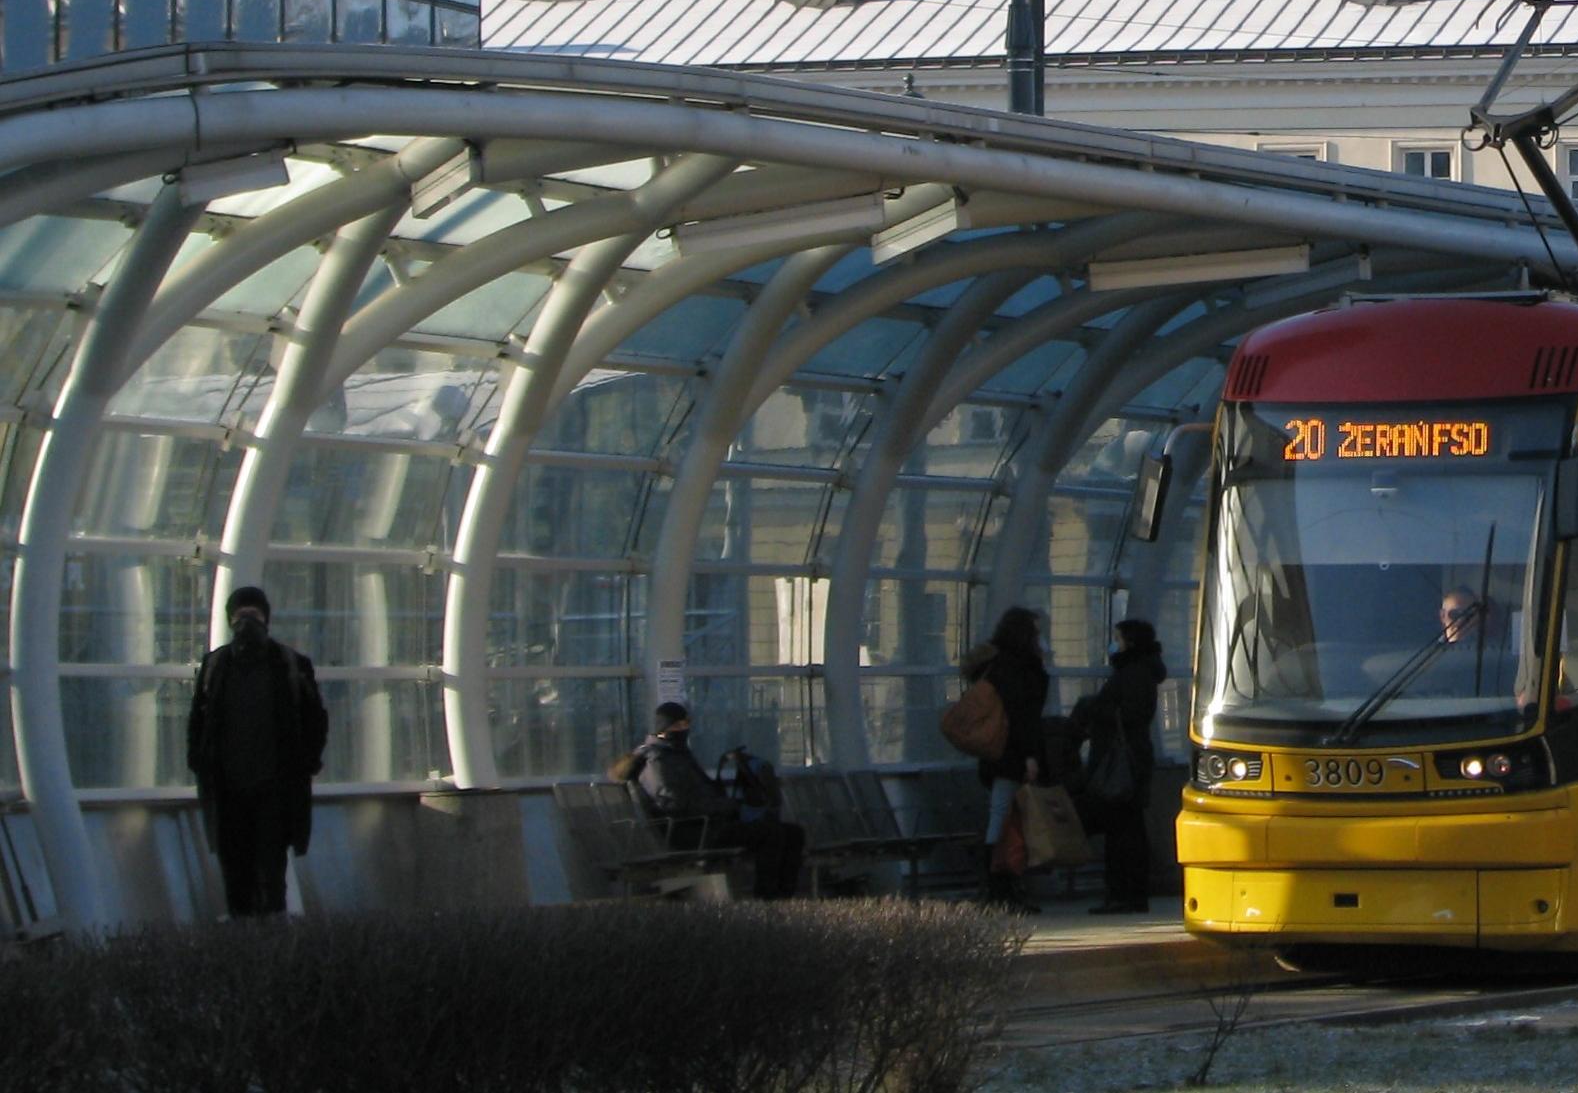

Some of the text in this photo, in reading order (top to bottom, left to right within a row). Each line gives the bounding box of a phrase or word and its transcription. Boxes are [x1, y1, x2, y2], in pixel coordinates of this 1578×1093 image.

[1284, 419, 1489, 460] 20 ŻERAŃ FSO
[1304, 758, 1385, 787] 3809
